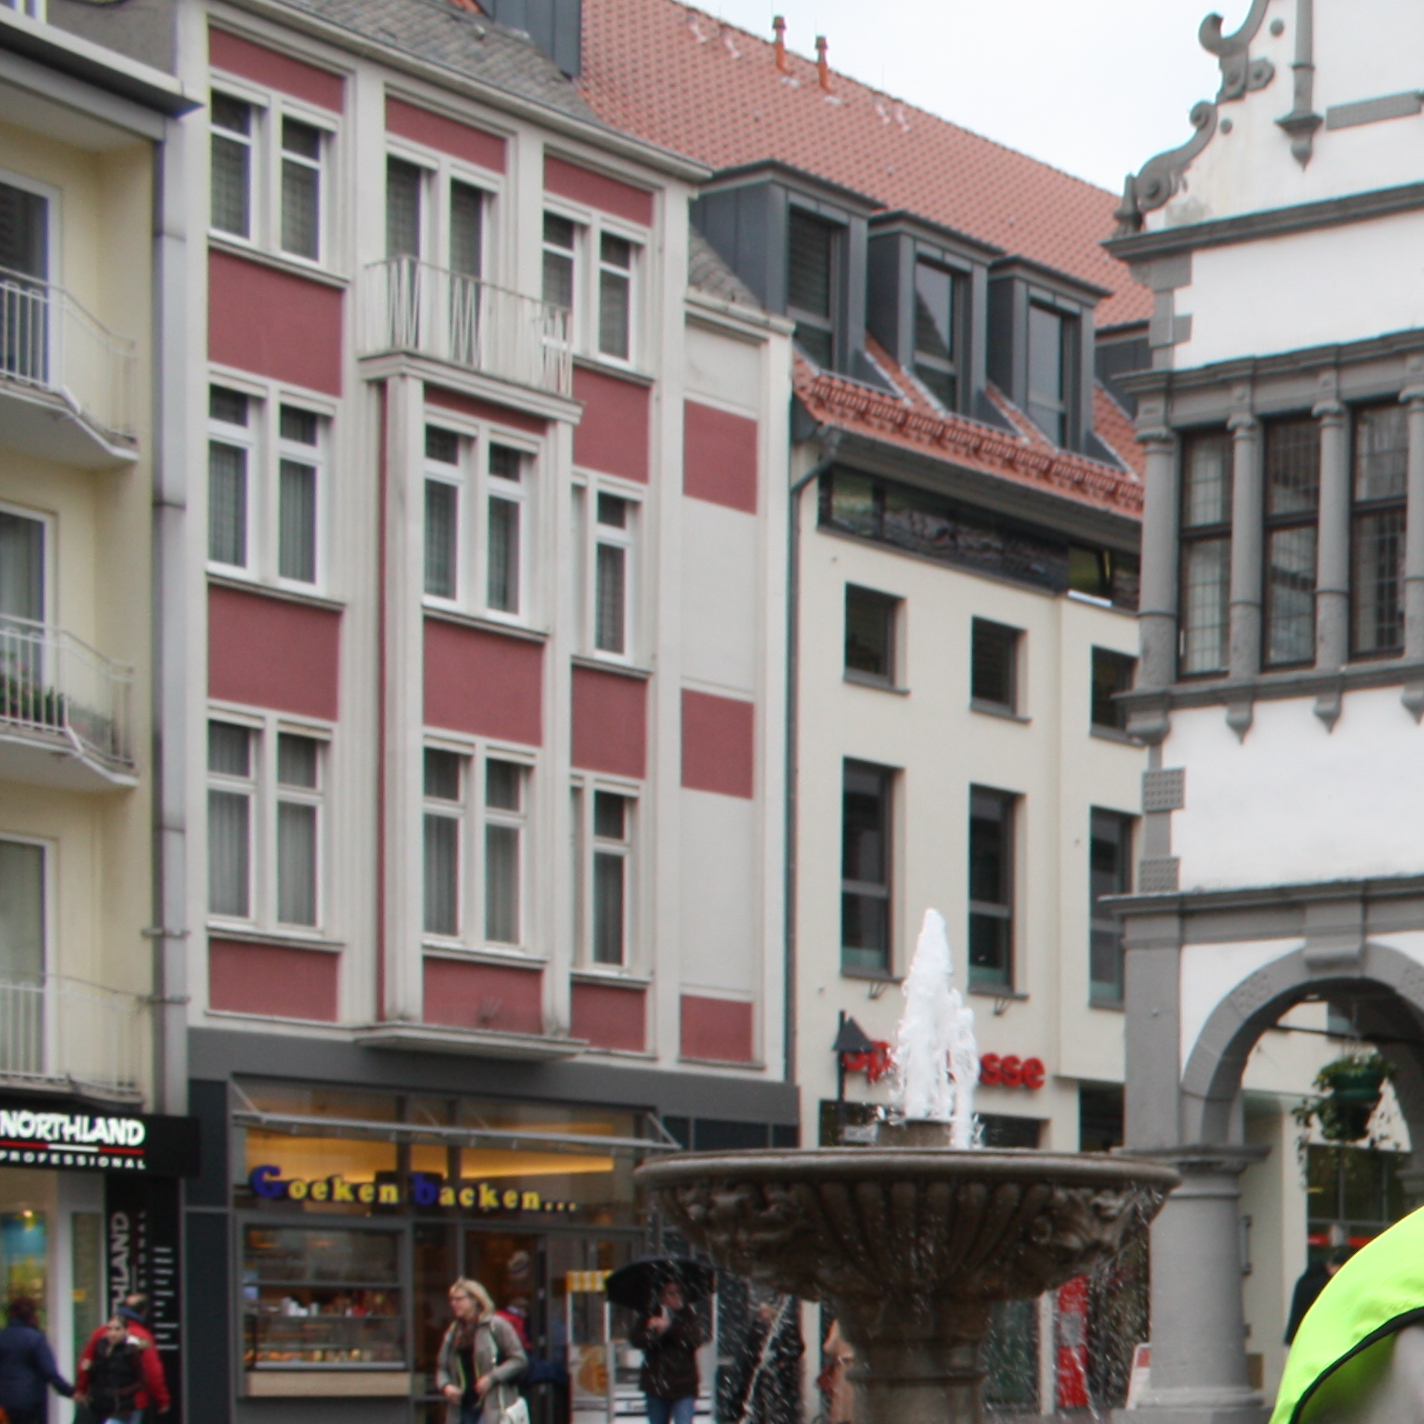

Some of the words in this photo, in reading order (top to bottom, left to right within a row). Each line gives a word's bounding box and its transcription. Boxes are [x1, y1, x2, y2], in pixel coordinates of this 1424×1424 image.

[0, 1110, 146, 1146] NORTHLAND
[0, 1150, 146, 1170] PROFESSIONAL
[250, 1164, 399, 1204] Goeken
